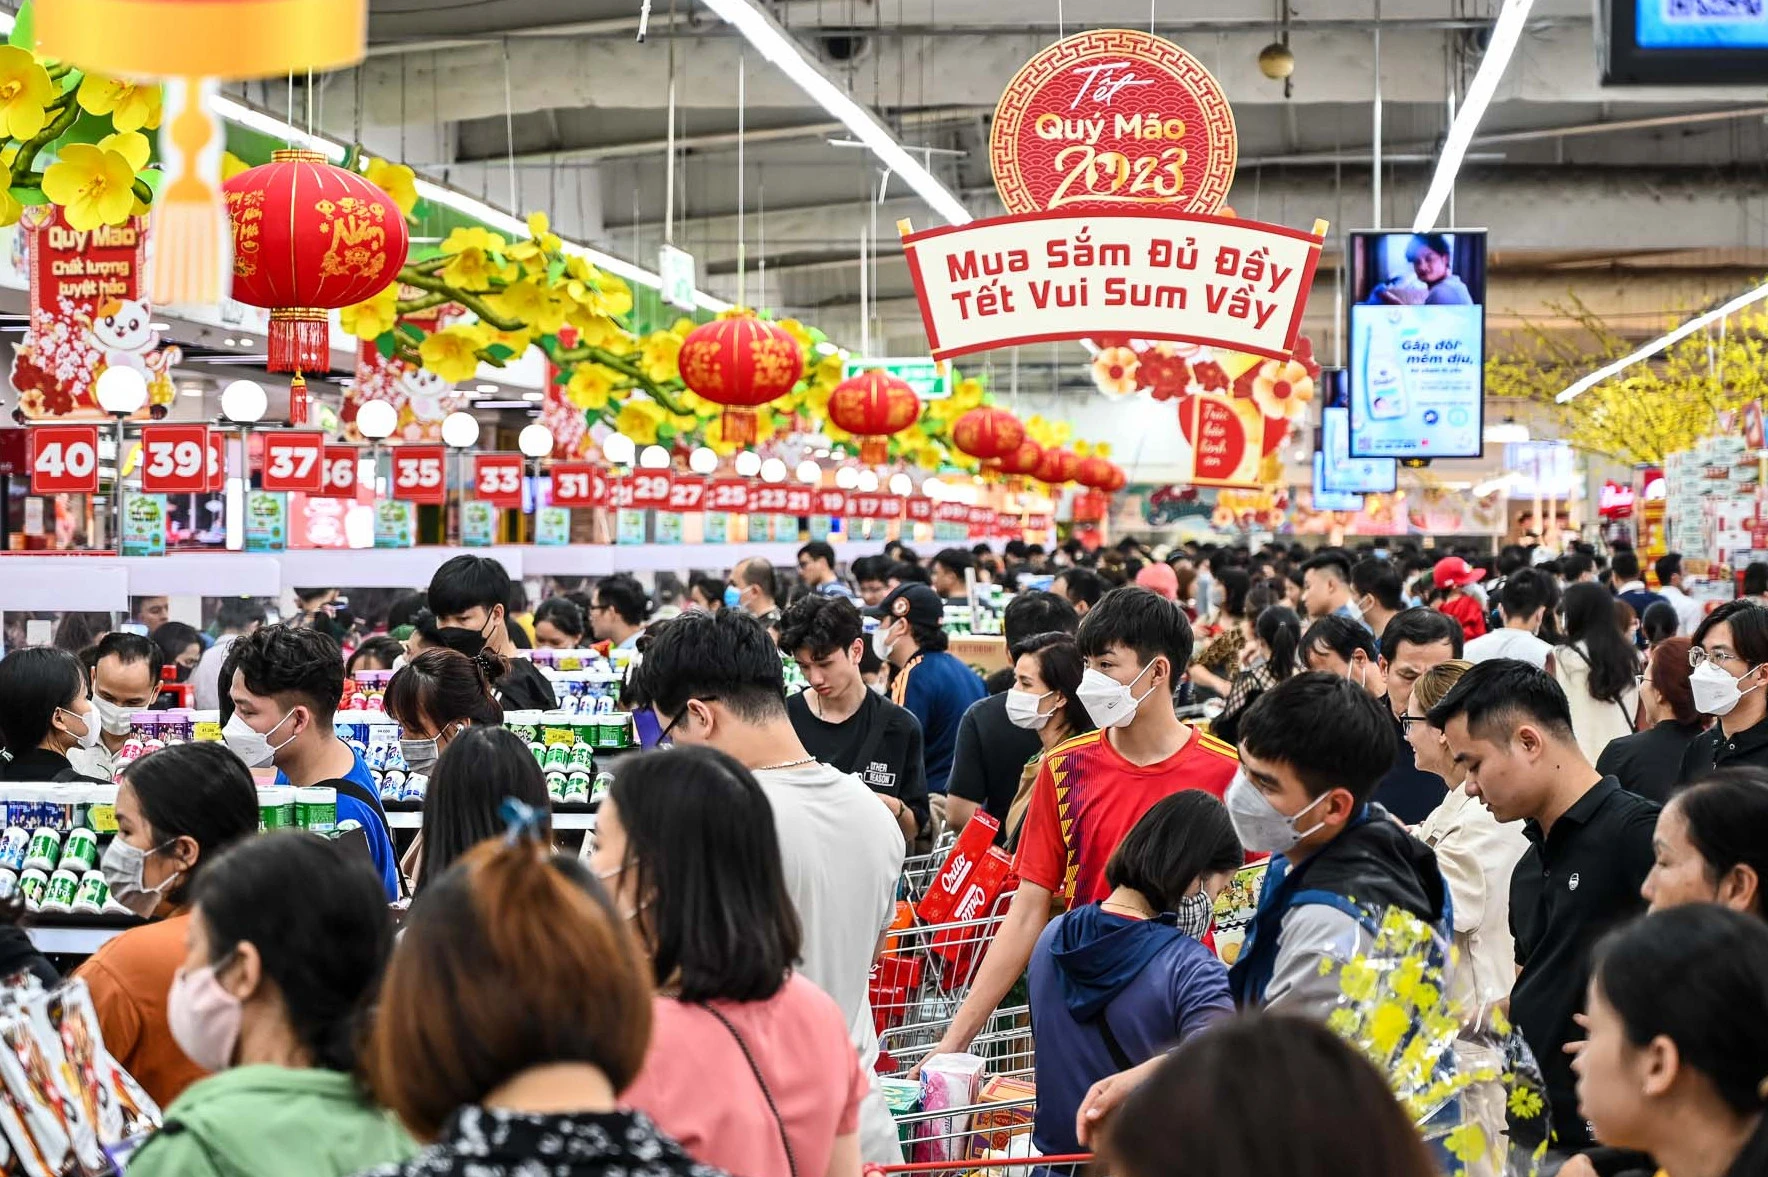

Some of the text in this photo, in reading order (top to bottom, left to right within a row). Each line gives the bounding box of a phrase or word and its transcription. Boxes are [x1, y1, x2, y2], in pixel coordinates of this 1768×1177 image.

[1070, 62, 1155, 109] Tết
[1035, 112, 1186, 145] Quý Mão
[1047, 145, 1188, 210] 2023
[52, 256, 84, 276] Chất
[947, 226, 1292, 294] Mua Sắm Đủ Đầy
[952, 277, 1277, 330] Tết Vui Sum Vầy
[35, 441, 95, 478] 40
[147, 441, 202, 478] 39
[268, 446, 319, 479] 37
[396, 458, 442, 487] 35
[479, 465, 520, 494] 33
[557, 473, 589, 499] 31
[634, 475, 670, 500] 29
[669, 484, 704, 507] 27
[716, 485, 748, 506] 25
[758, 489, 788, 509] 23
